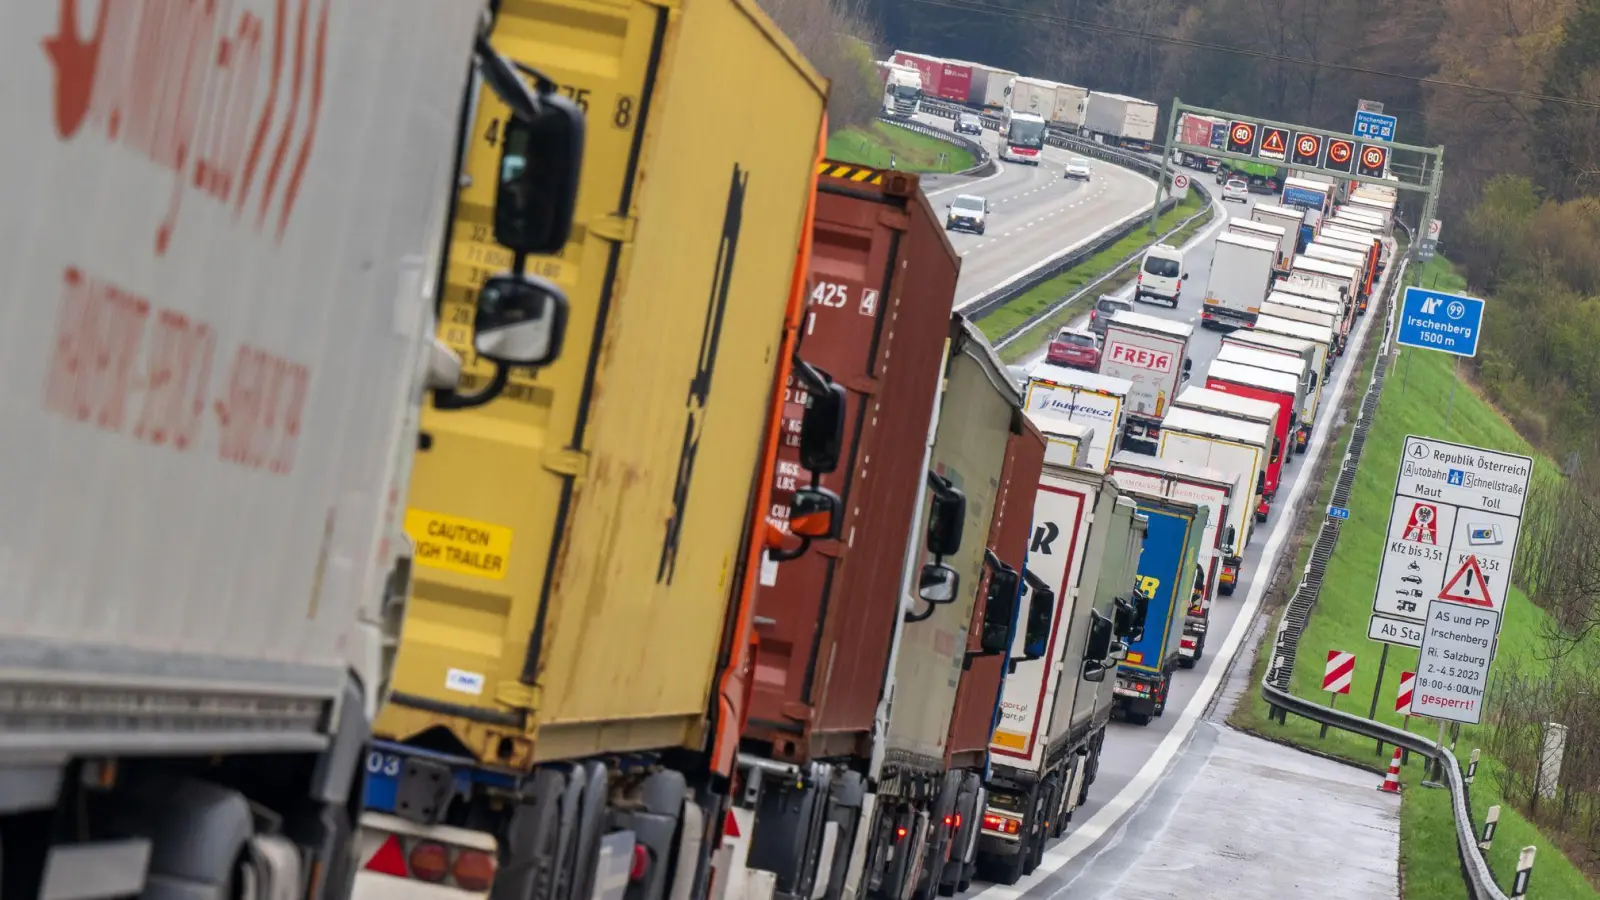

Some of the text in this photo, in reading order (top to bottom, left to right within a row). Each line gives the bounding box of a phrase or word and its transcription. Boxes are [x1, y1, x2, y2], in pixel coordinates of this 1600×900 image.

[615, 96, 632, 129] 8
[1358, 114, 1393, 127] Irschenberg
[1236, 129, 1248, 140] 80
[1301, 140, 1313, 152] 80
[1368, 152, 1379, 163] 80
[863, 290, 877, 315] 4
[1449, 305, 1463, 316] 99
[1407, 316, 1472, 338] Irschenberg
[1420, 331, 1455, 346] 1500 m
[1112, 345, 1168, 369] FREJA
[1413, 445, 1527, 476] A Republik Österreich
[1404, 461, 1523, 495] Autobahn Schnellstraße
[1415, 483, 1442, 498] Maut
[1482, 496, 1501, 509] Toll
[427, 519, 490, 547] CAUTION
[1029, 521, 1060, 555] R
[414, 539, 503, 573] IGH TRAILER
[1391, 541, 1443, 561] Kfz bis 3,5t
[1435, 611, 1490, 628] AS und PP
[1381, 623, 1423, 641] Ab Sta
[1431, 627, 1488, 648] Irschenberg
[1427, 646, 1485, 667] Ri. Salzburg
[1427, 663, 1479, 681] 2.-4.5.2023
[1421, 694, 1474, 711] gesperrt!
[366, 752, 400, 776] 03
